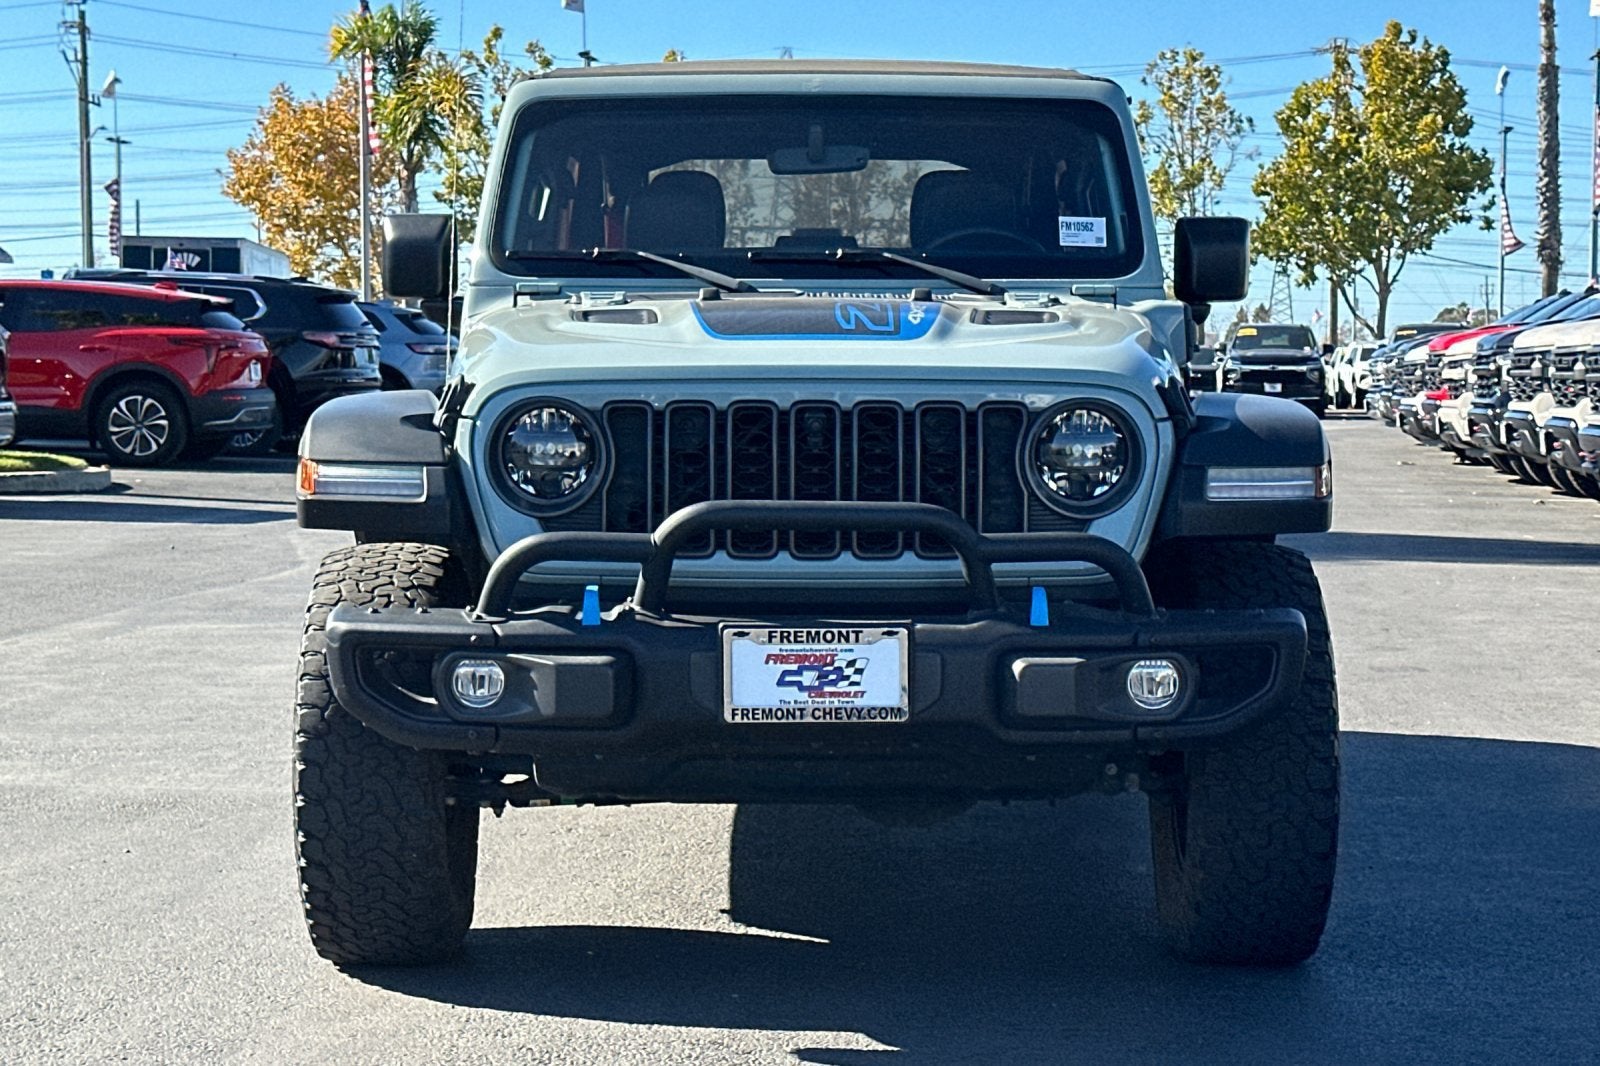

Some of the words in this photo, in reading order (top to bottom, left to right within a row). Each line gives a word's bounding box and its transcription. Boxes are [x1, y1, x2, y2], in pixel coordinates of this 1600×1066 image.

[1060, 221, 1094, 232] FM10562
[767, 630, 863, 644] FREMONT
[764, 653, 839, 666] FREMONT
[731, 708, 806, 721] FREMONT
[811, 707, 902, 721] CHEVY.COM
